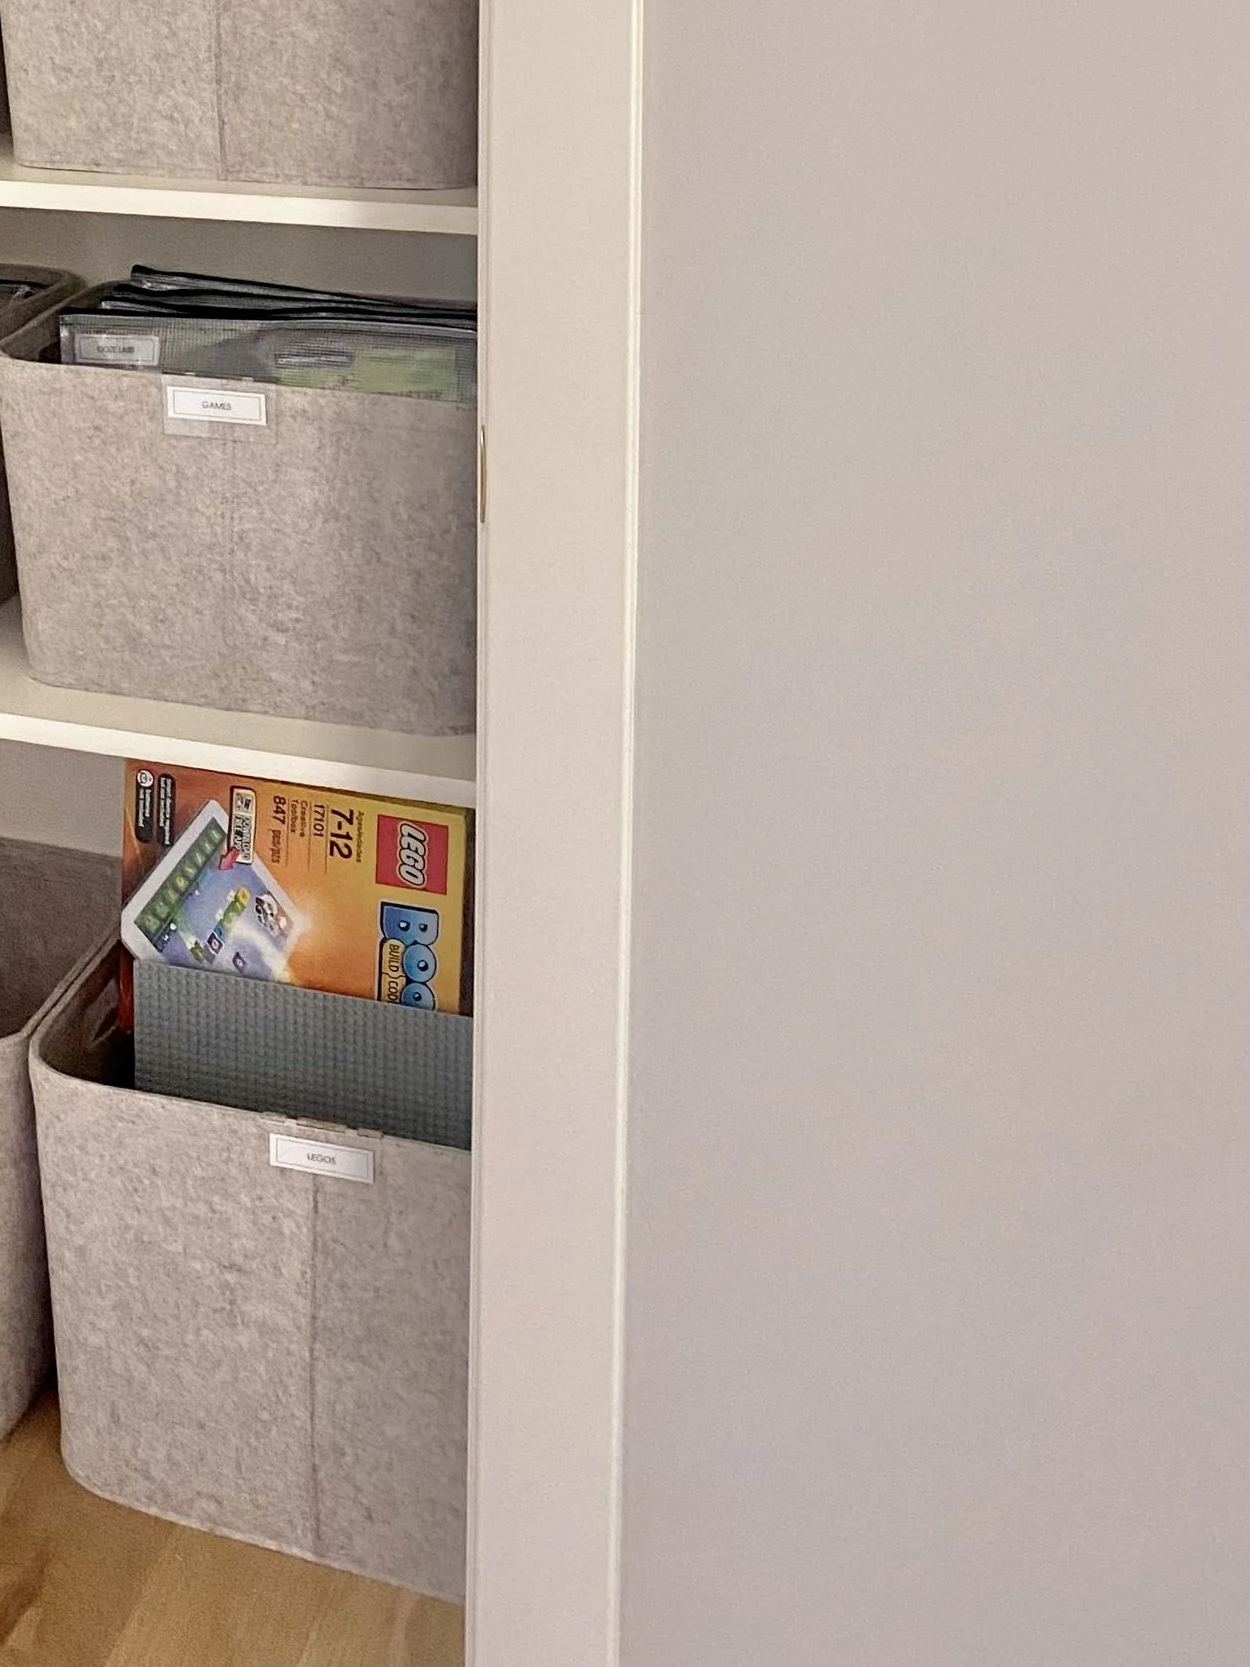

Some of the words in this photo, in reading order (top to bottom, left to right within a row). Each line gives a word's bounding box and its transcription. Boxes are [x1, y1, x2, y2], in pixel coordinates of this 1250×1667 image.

[202, 401, 231, 411] GAMES
[273, 795, 287, 825] 847
[290, 799, 299, 834] Toolbox
[299, 800, 308, 838] Creative
[313, 804, 325, 837] 17101
[329, 809, 354, 860] 7-12
[399, 822, 427, 887] LEGO
[388, 944, 401, 973] BUILD
[387, 981, 400, 1005] COD
[306, 1152, 336, 1165] LEGOS
